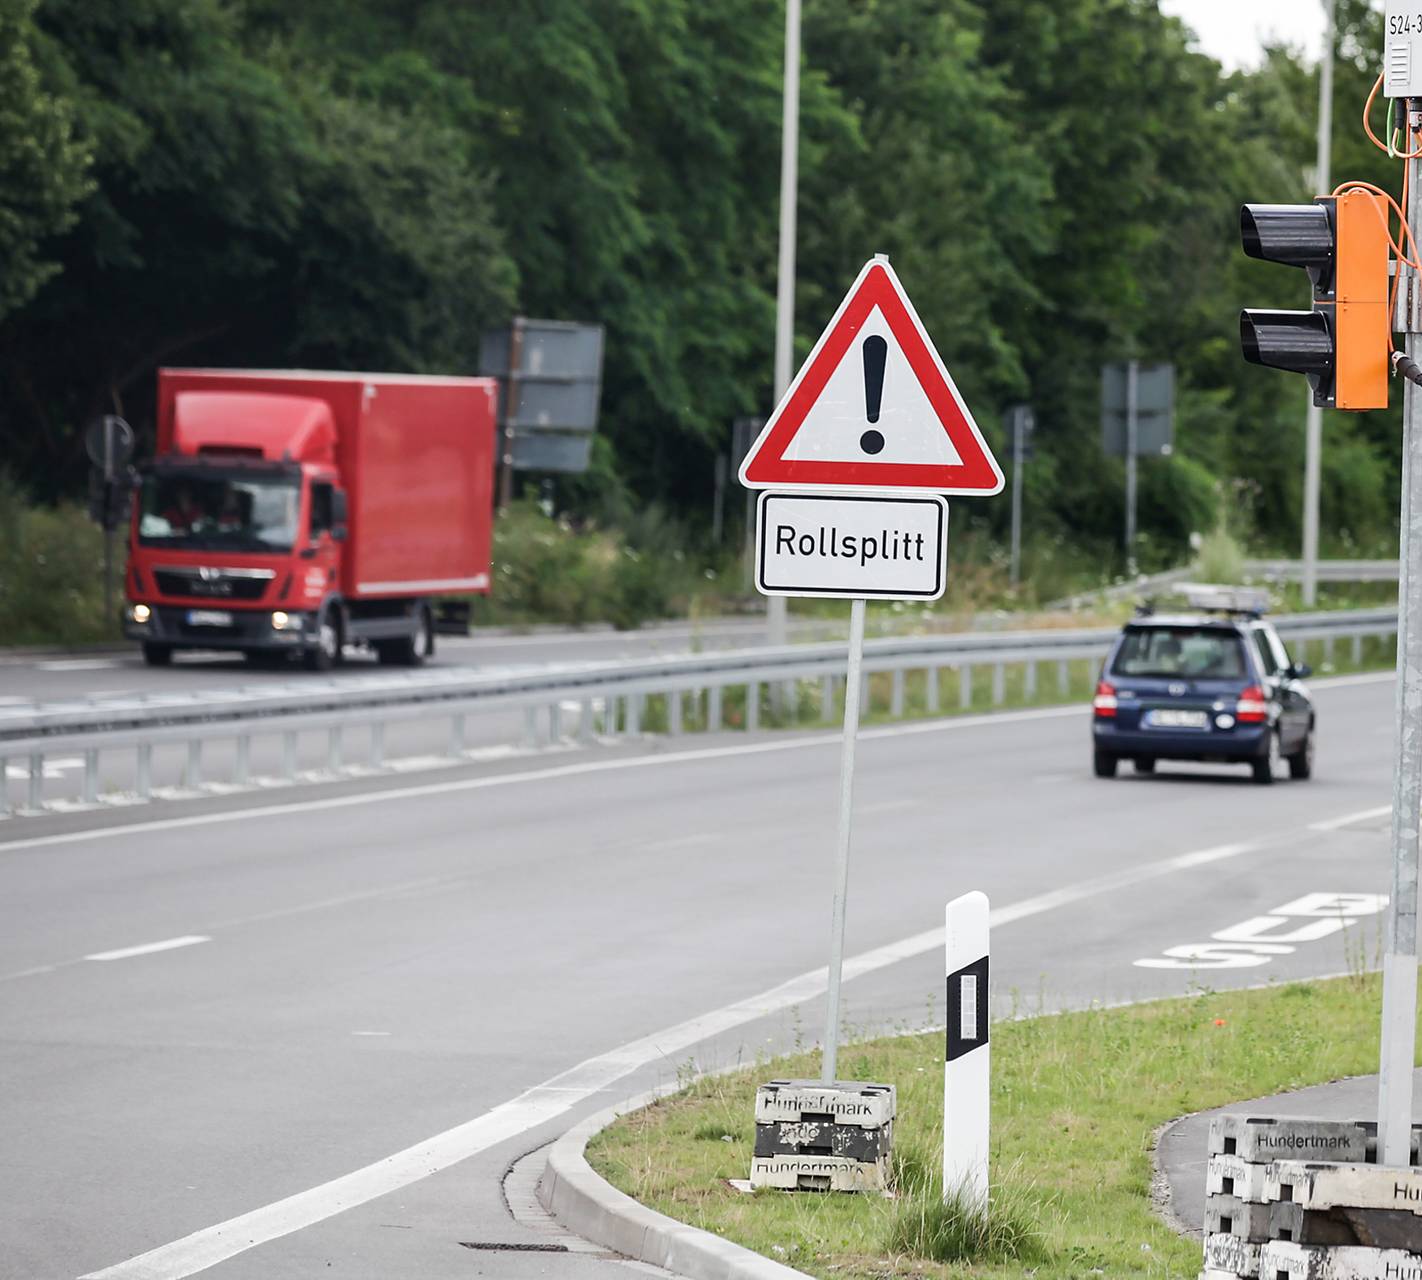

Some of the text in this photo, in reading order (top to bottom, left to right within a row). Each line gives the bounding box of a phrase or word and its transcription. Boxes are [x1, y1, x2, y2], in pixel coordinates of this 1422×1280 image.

[775, 524, 925, 566] Rollsplitt
[1132, 892, 1390, 969] BUS
[1257, 1134, 1351, 1150] Hundertmark
